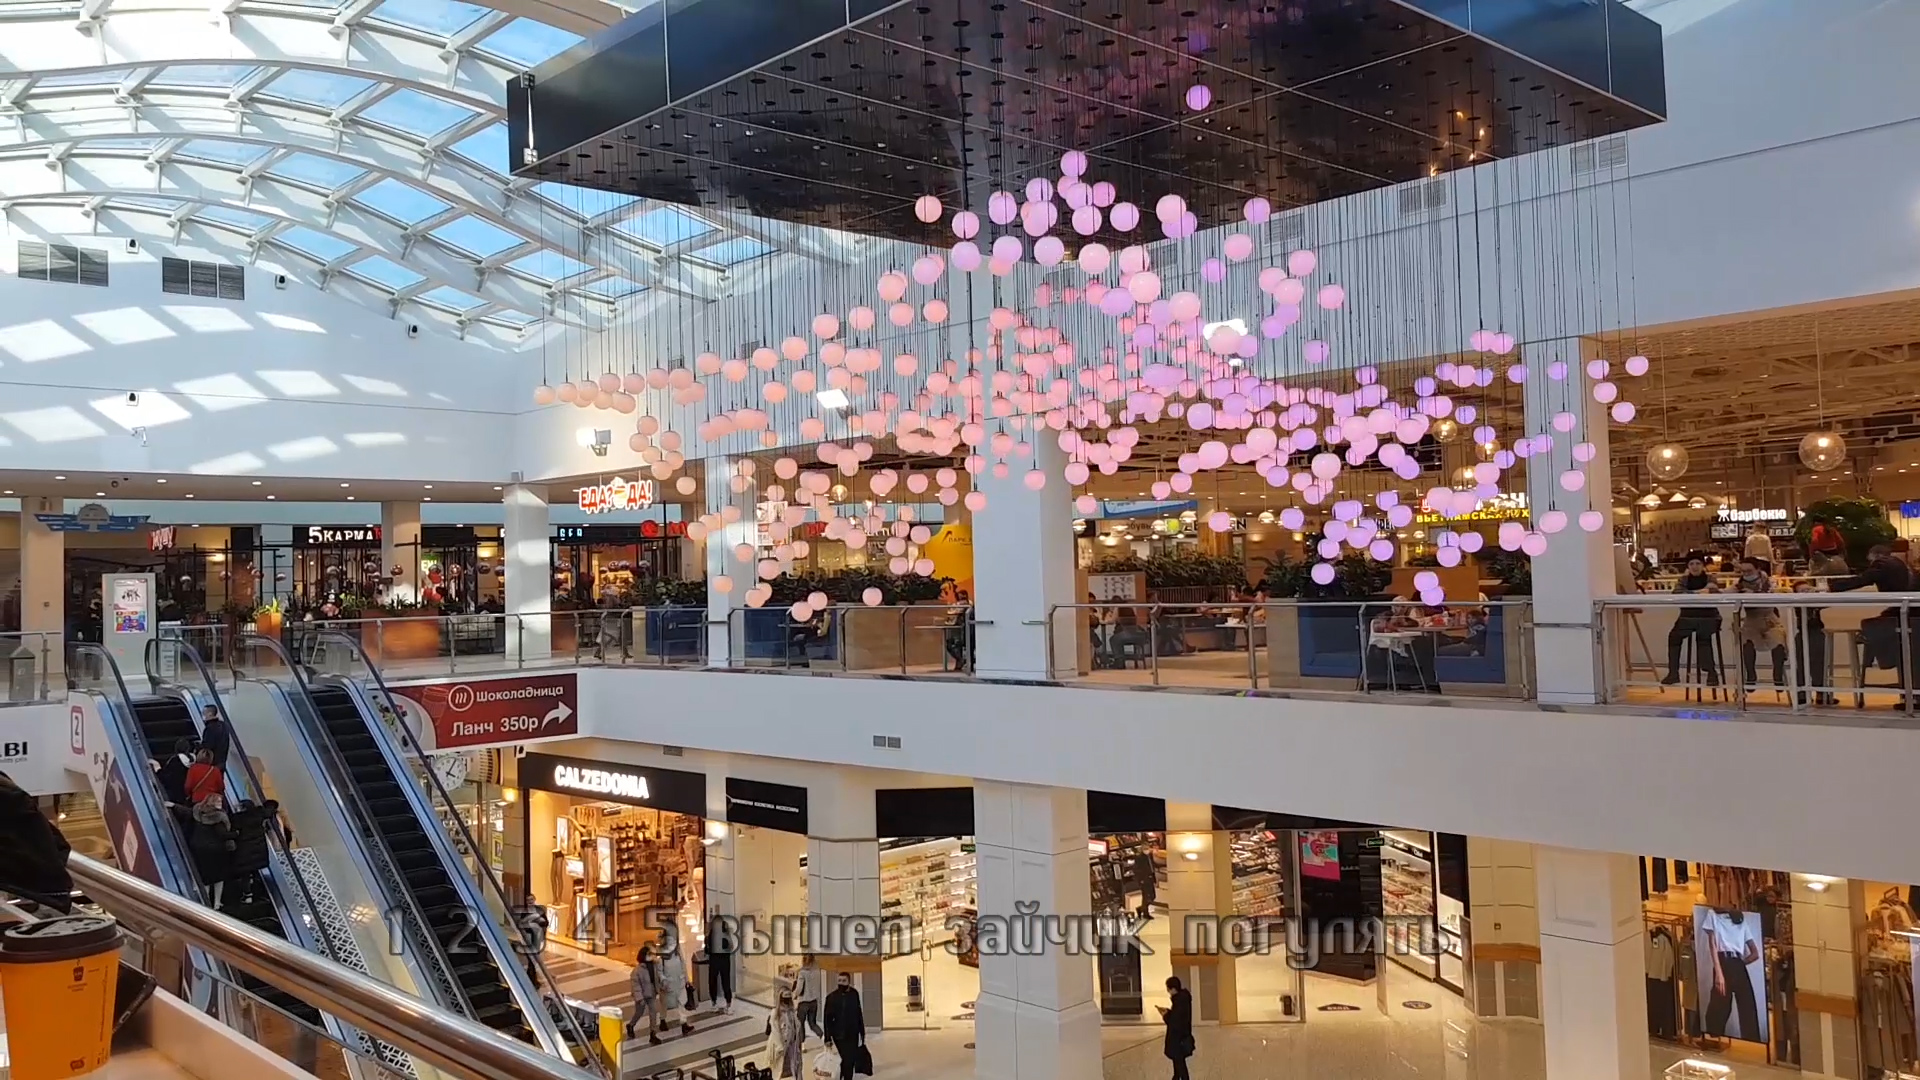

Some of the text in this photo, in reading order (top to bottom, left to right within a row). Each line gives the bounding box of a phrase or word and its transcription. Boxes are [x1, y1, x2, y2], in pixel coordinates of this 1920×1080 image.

[578, 480, 653, 514] ЕДА? ДА!
[1730, 508, 1787, 521] барбекю
[476, 686, 564, 702] Шоколадница
[74, 715, 80, 736] 2
[451, 715, 538, 737] Ланч 350р
[0, 741, 28, 757] BI
[554, 764, 650, 799] CALZEDONIA
